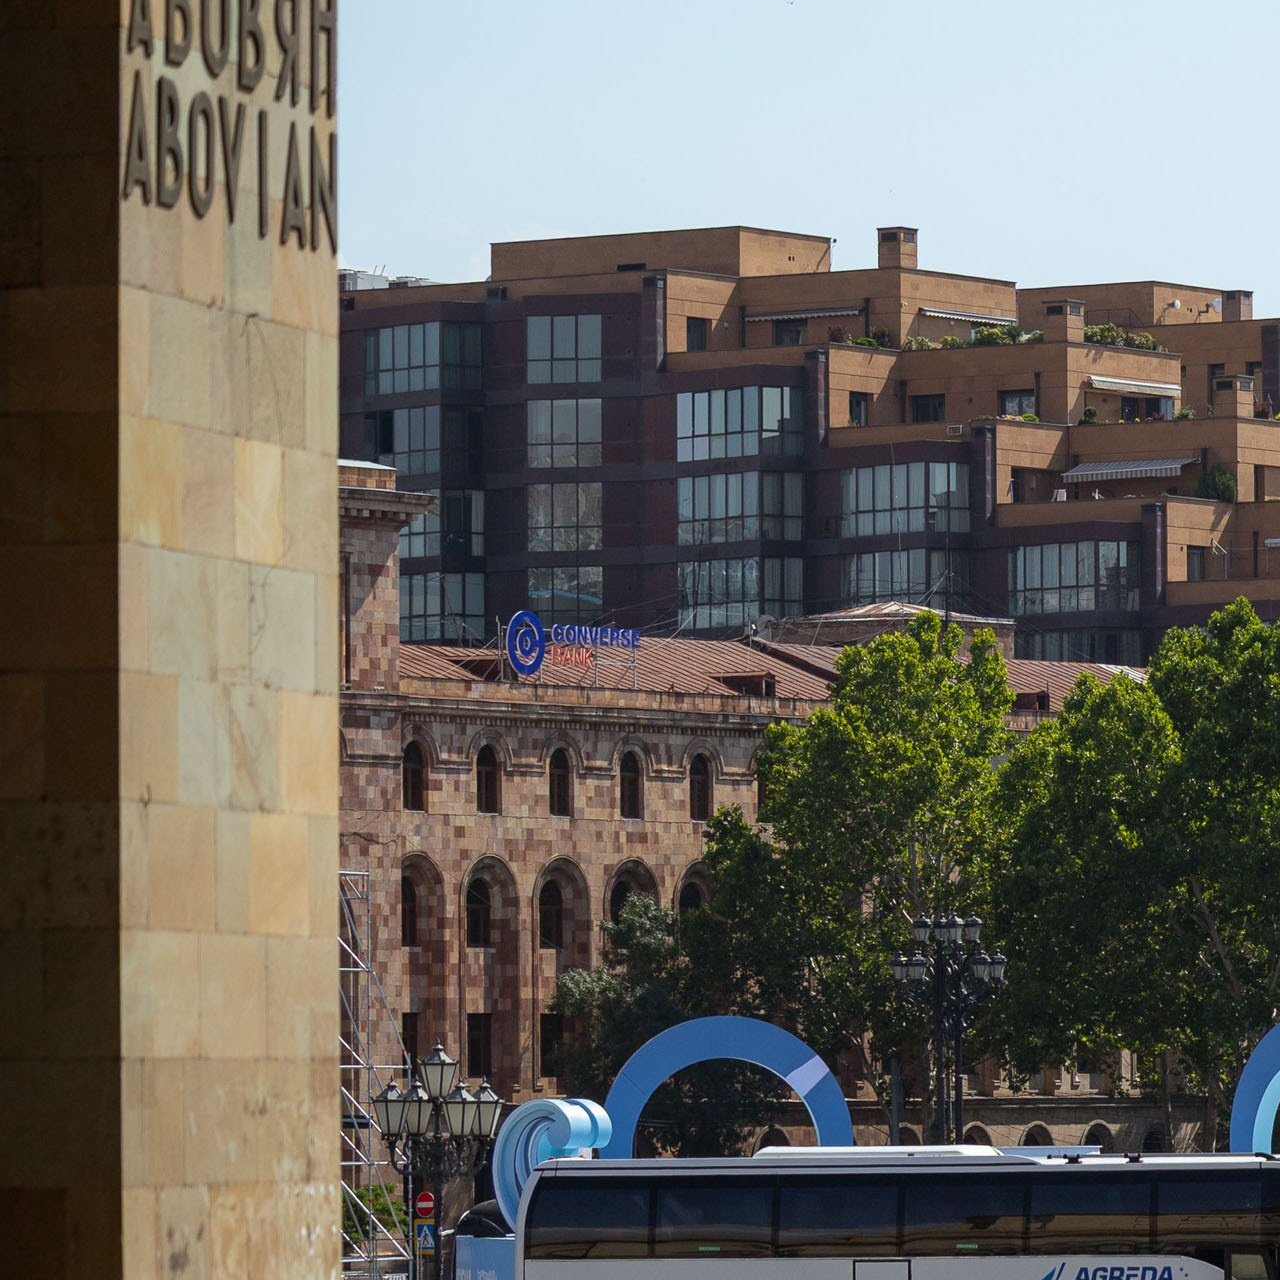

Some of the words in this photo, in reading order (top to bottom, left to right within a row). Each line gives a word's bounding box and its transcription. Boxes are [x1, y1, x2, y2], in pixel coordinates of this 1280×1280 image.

[123, 69, 338, 257] ABOVIAN
[551, 623, 641, 648] CONVERSE
[551, 645, 595, 668] BANK
